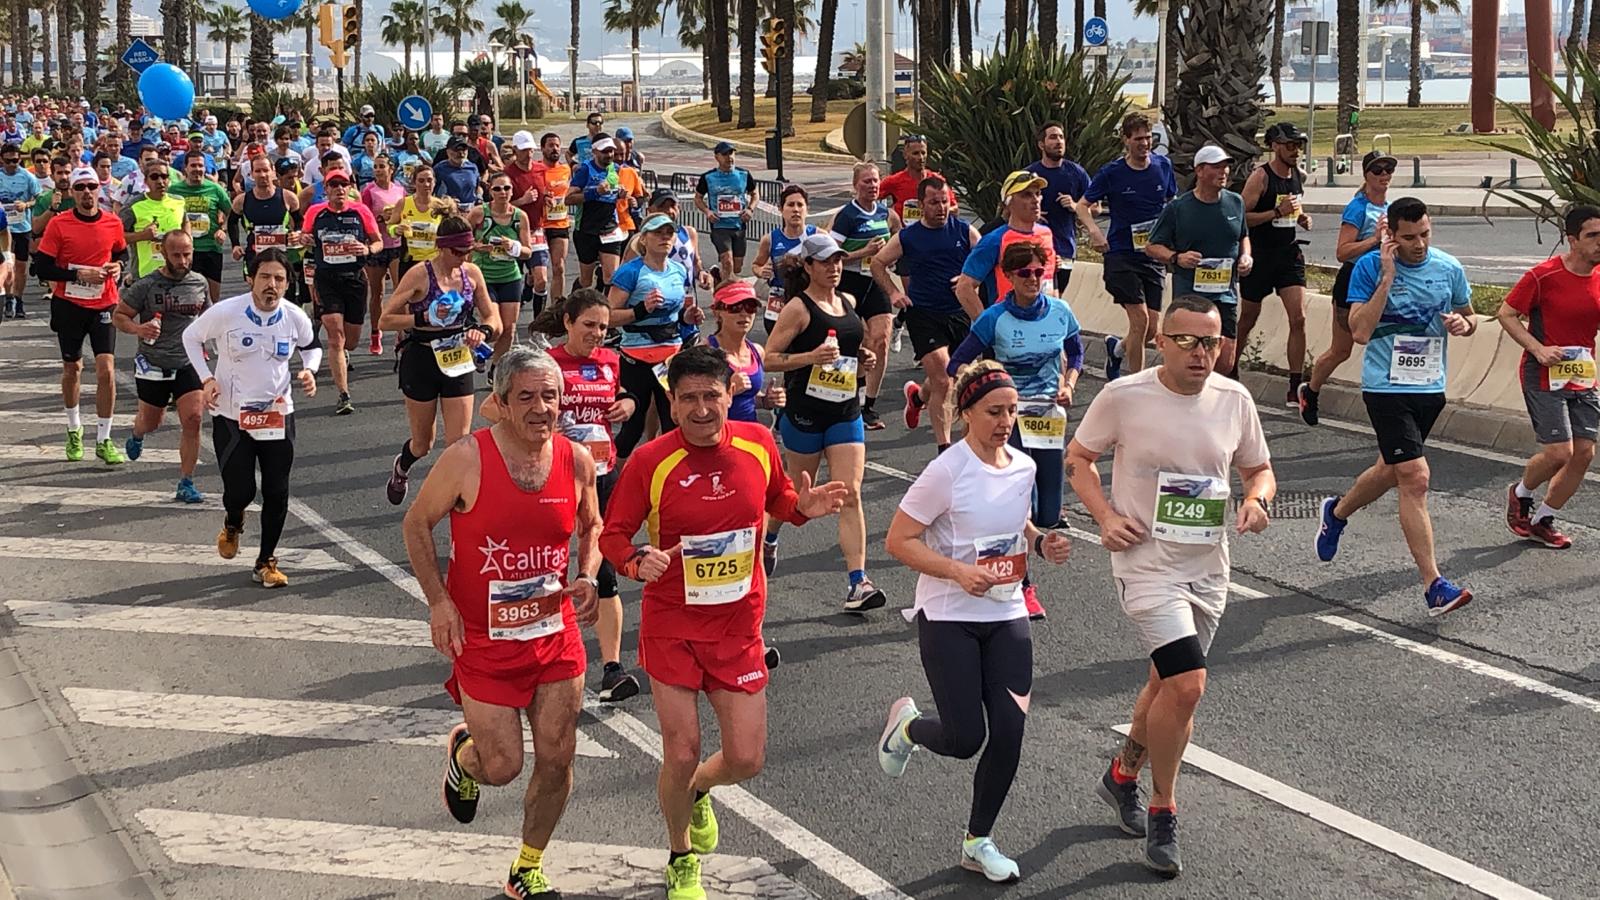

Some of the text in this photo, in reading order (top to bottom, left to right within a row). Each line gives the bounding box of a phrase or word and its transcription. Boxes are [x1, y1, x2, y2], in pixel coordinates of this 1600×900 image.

[1201, 271, 1222, 280] 7631
[442, 350, 462, 363] 6157
[1397, 355, 1426, 367] 9695
[1558, 363, 1584, 374] 7663
[818, 371, 846, 385] 6744
[243, 414, 269, 426] 4957
[1023, 420, 1051, 431] 6804
[1164, 500, 1206, 519] 1249
[695, 559, 738, 579] 6725
[497, 602, 540, 622] 3963
